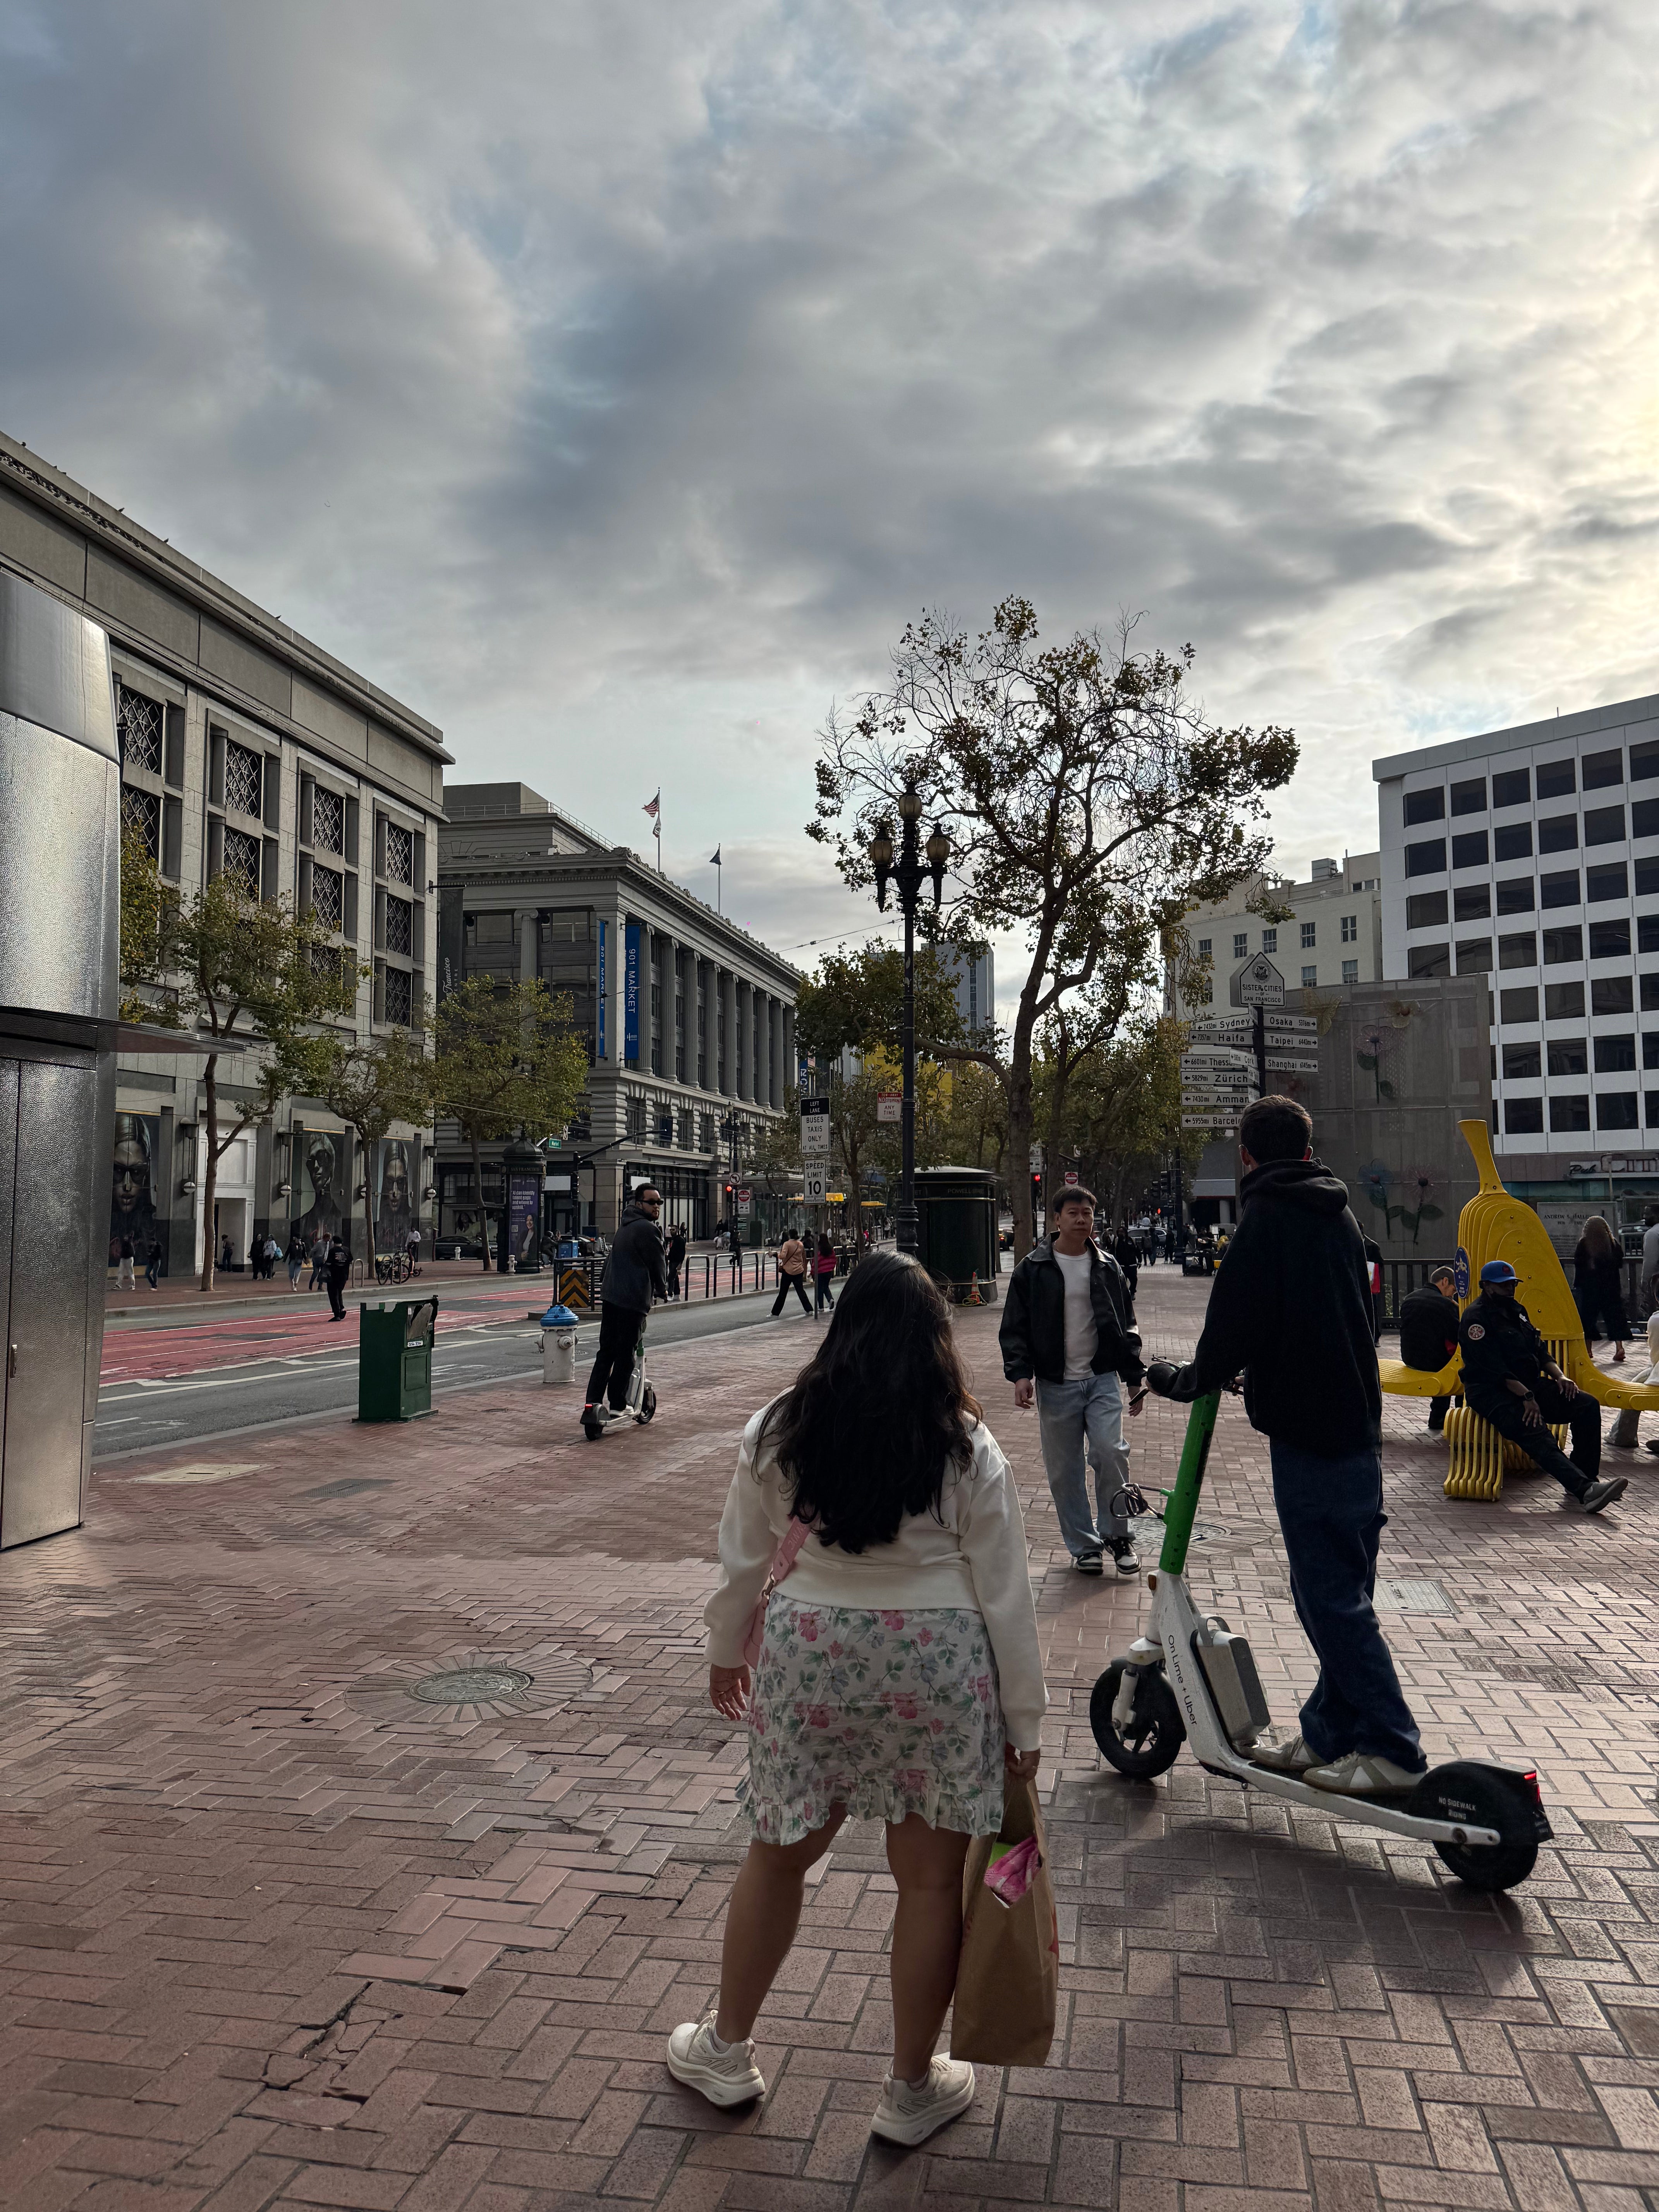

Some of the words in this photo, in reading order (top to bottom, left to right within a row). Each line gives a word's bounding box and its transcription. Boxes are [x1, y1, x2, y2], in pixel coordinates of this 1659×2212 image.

[442, 957, 453, 994] Francisco
[1220, 1018, 1250, 1029] Sydney
[1270, 1017, 1293, 1026] Osaka
[1218, 1034, 1245, 1042] Haifa
[1270, 1036, 1293, 1046] Taipei
[1244, 1055, 1254, 1065] Cork
[1268, 1059, 1297, 1070] Shanghai
[1215, 1074, 1248, 1082] Zürich
[808, 1180, 821, 1195] 10
[1168, 1635, 1175, 1653] On
[1172, 1654, 1183, 1684] Lime
[1184, 1695, 1197, 1725] Uber
[1438, 1796, 1446, 1804] NO
[1448, 1798, 1476, 1811] SIDEWALK
